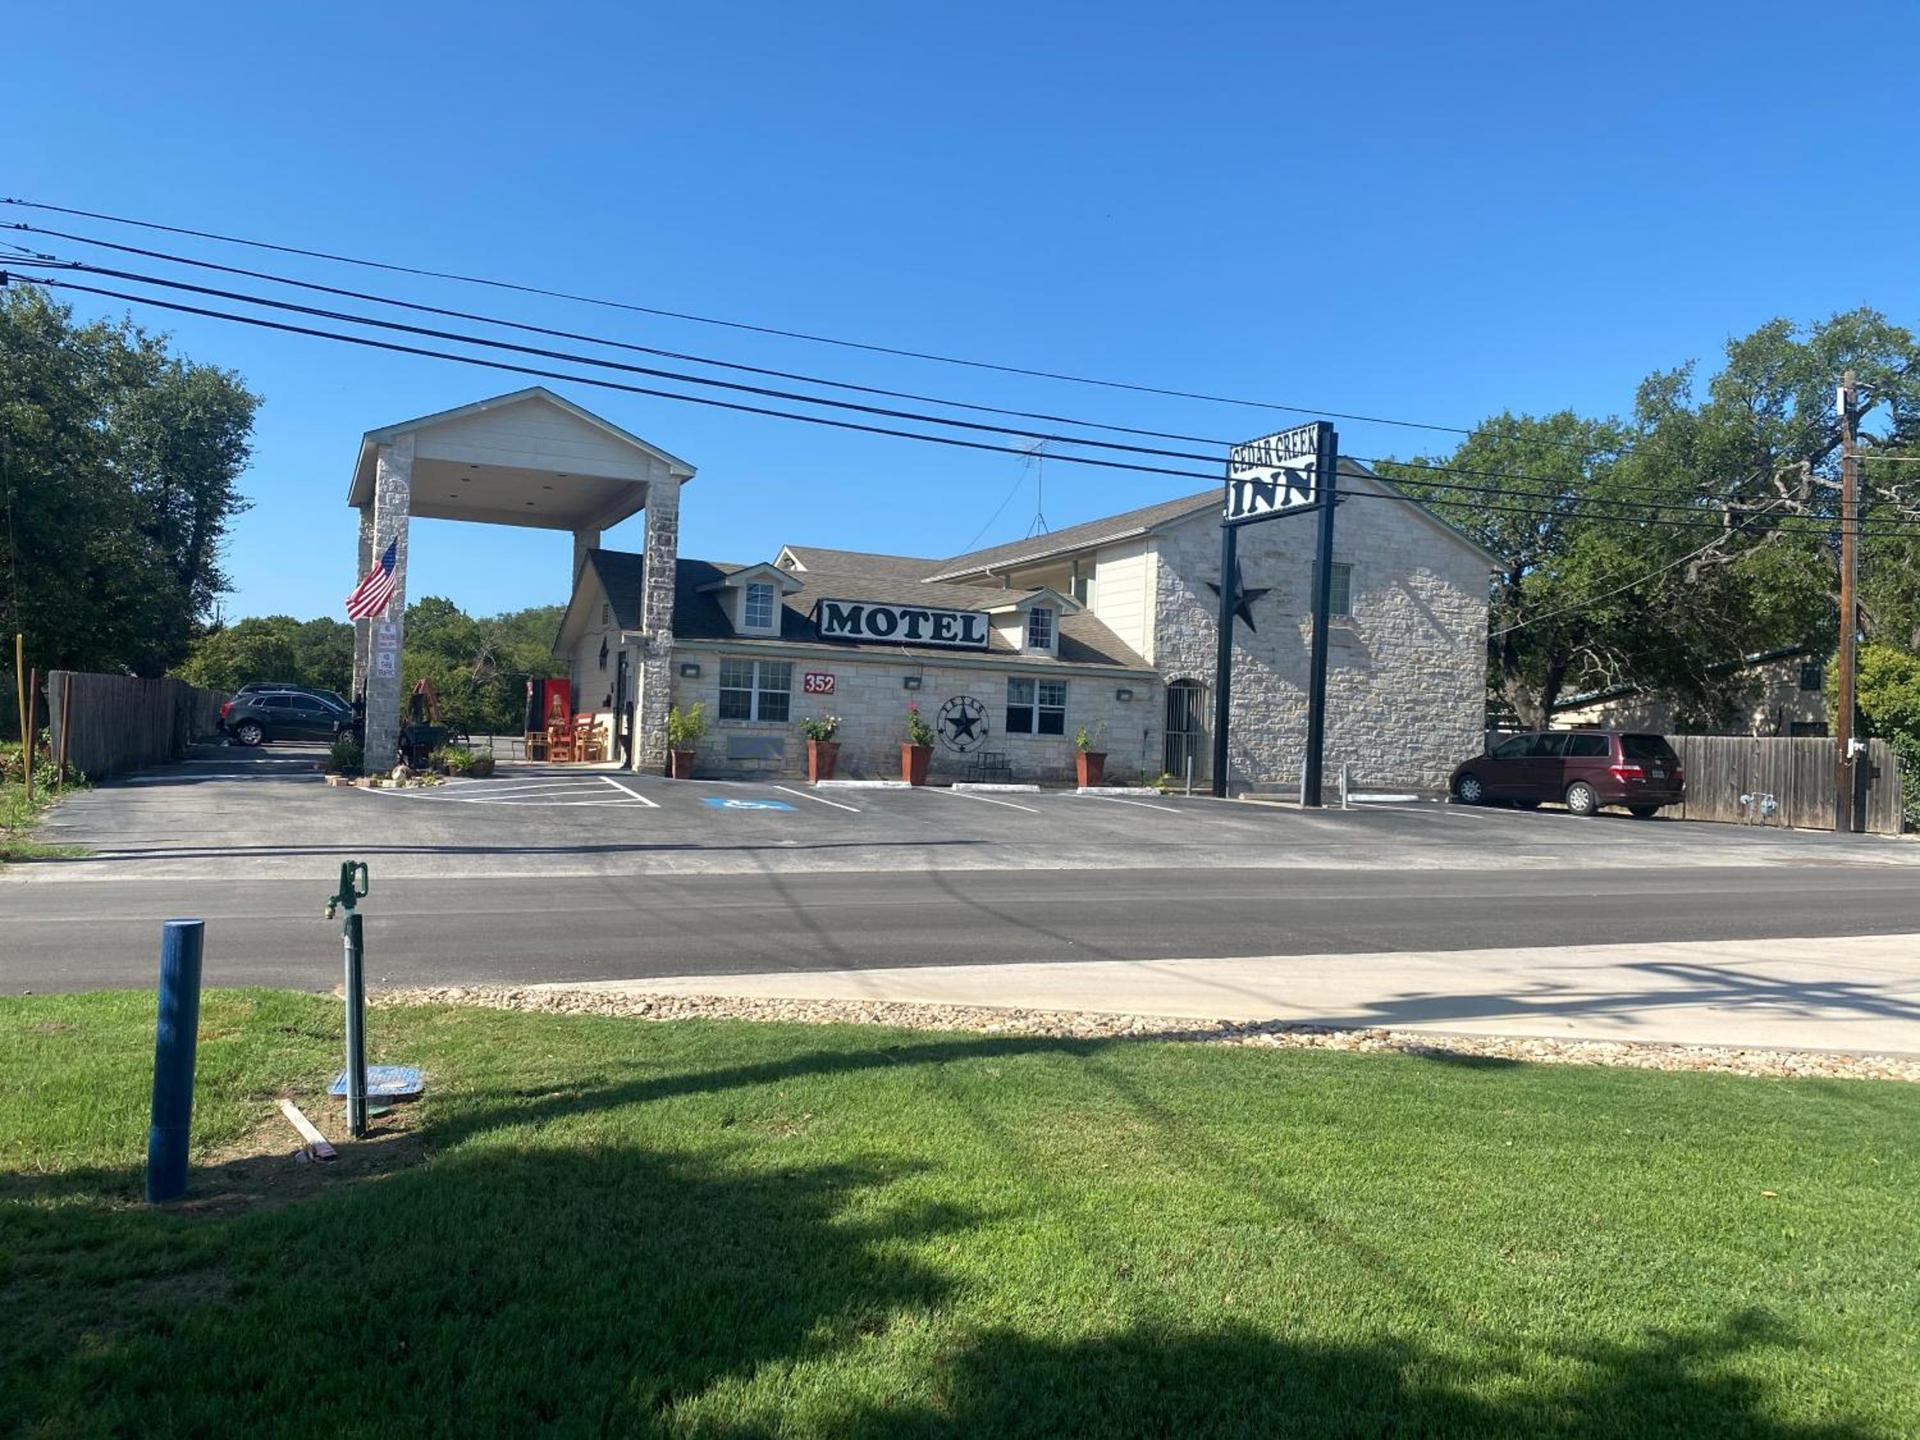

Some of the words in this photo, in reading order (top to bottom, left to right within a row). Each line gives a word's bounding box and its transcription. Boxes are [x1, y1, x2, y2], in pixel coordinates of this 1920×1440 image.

[1232, 439, 1272, 474] CEDAR
[1276, 426, 1317, 463] CREEK
[1231, 462, 1315, 517] INN
[824, 603, 985, 643] MOTEL
[806, 674, 834, 693] 352
[942, 695, 986, 714] TEXAS
